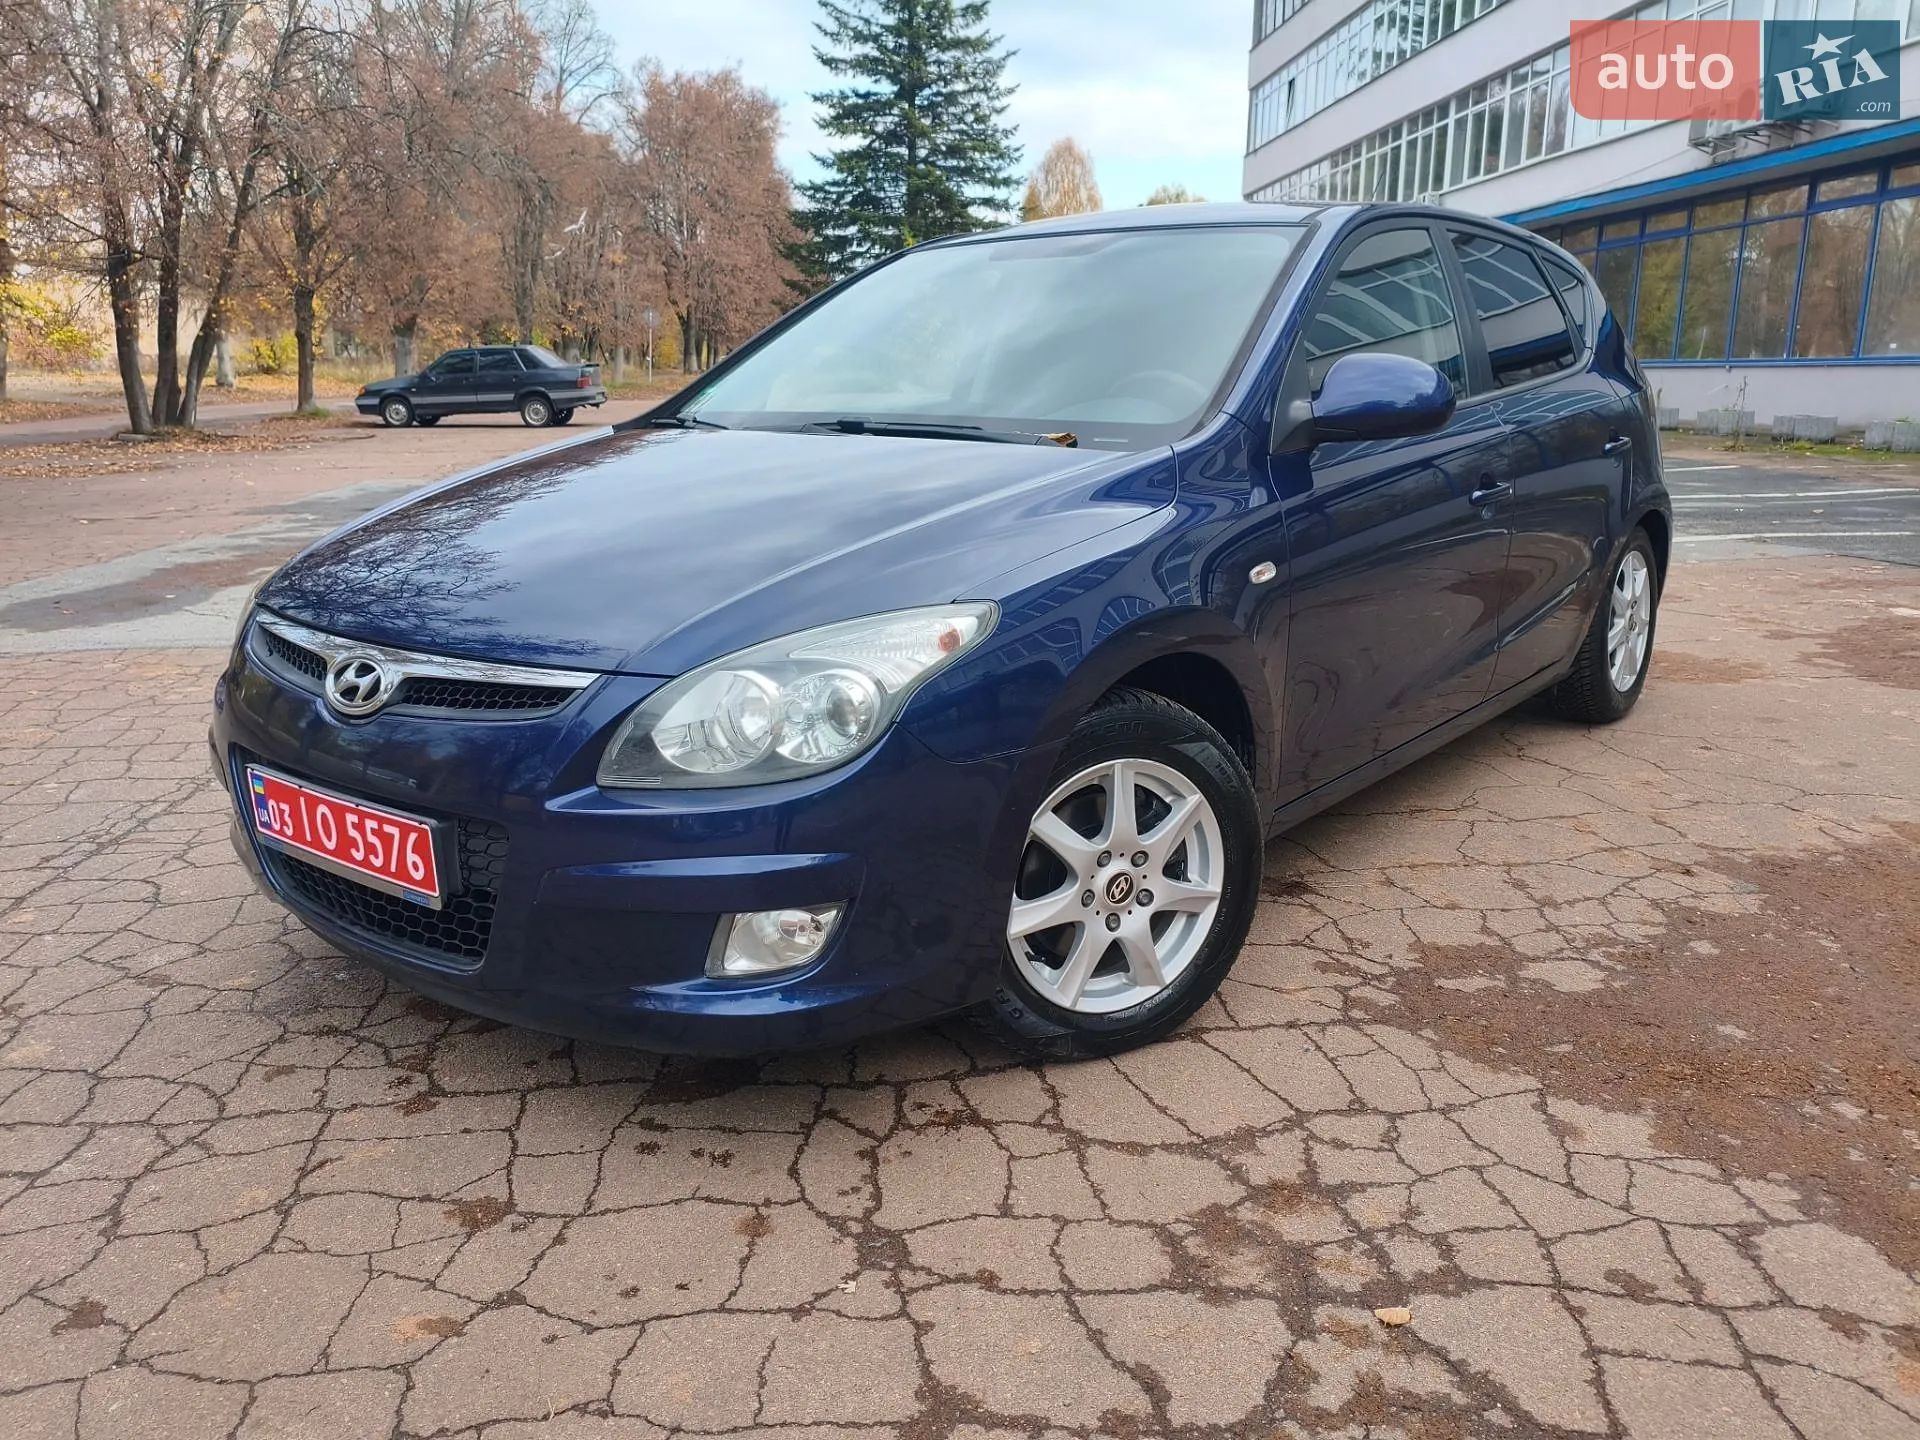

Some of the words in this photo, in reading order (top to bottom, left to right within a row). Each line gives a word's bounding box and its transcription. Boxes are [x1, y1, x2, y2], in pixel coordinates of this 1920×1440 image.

[258, 807, 271, 824] UA
[268, 798, 294, 837] 03
[345, 812, 425, 881] 5576
